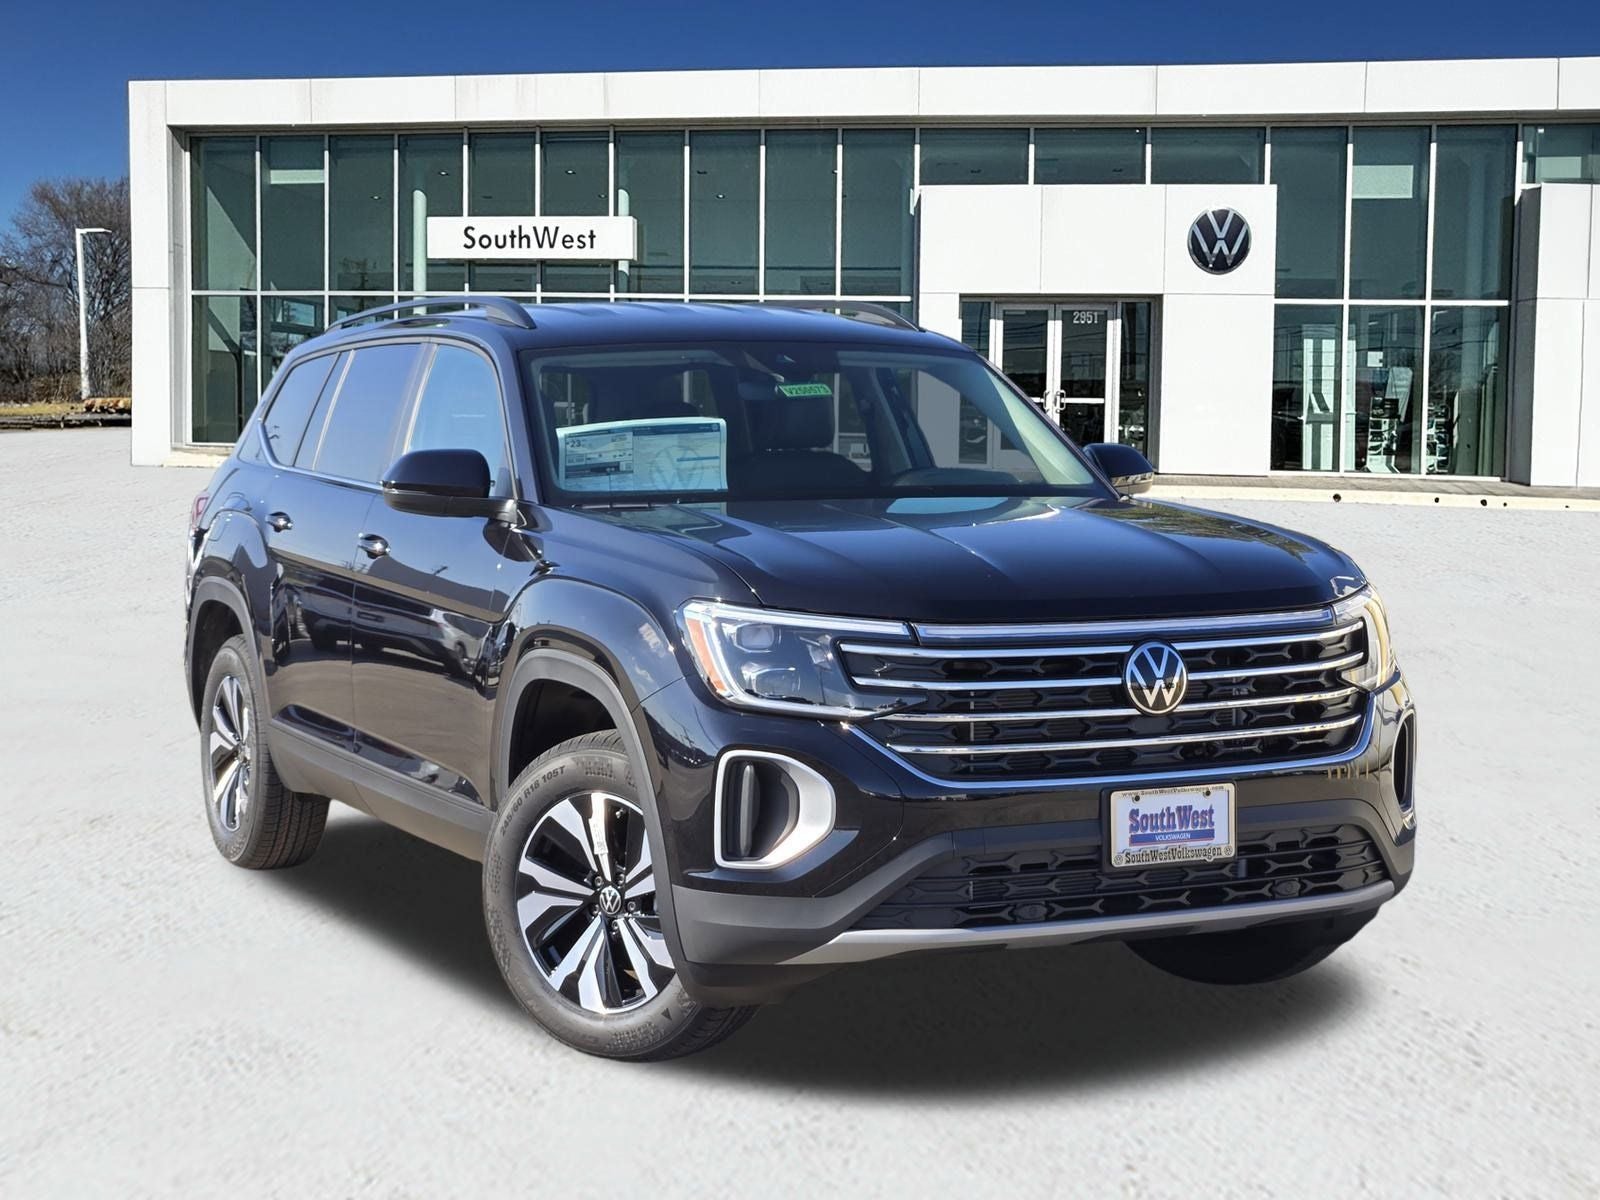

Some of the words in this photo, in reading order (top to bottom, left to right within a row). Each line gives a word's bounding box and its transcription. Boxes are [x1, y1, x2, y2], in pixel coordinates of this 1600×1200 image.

[463, 225, 597, 250] SouthWest
[1073, 311, 1098, 324] 2951
[501, 799, 523, 836] 245/60
[523, 779, 541, 801] R18
[541, 764, 566, 784] 105T
[1128, 803, 1215, 834] SouthWest
[1155, 833, 1191, 841] VOLKSWAGEN
[1124, 846, 1223, 865] SouthWestVolkswagen
